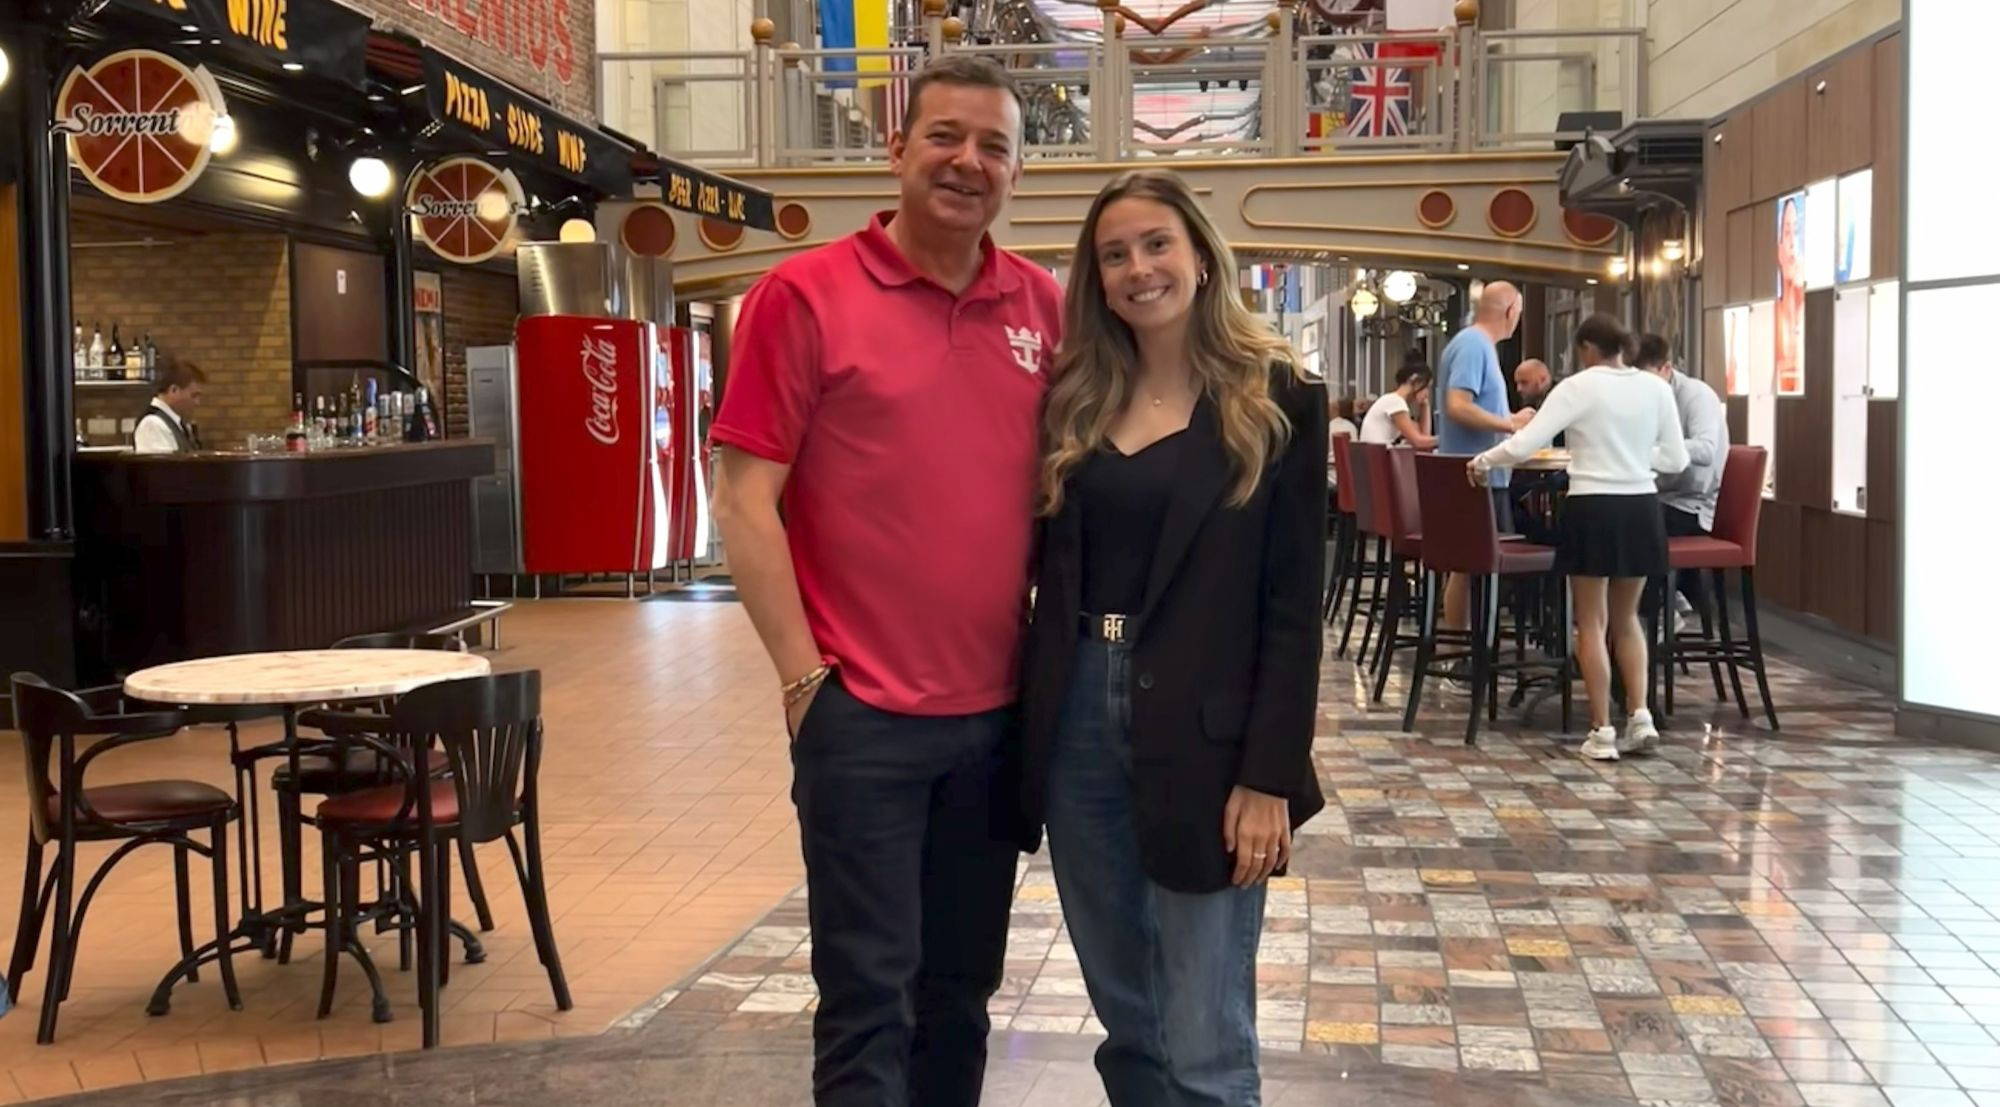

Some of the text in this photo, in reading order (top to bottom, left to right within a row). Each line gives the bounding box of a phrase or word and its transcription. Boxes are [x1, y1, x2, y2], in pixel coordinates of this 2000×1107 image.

[444, 70, 491, 131] PIZZA
[507, 103, 545, 155] SLICE
[580, 334, 620, 444] Coca-Cola
